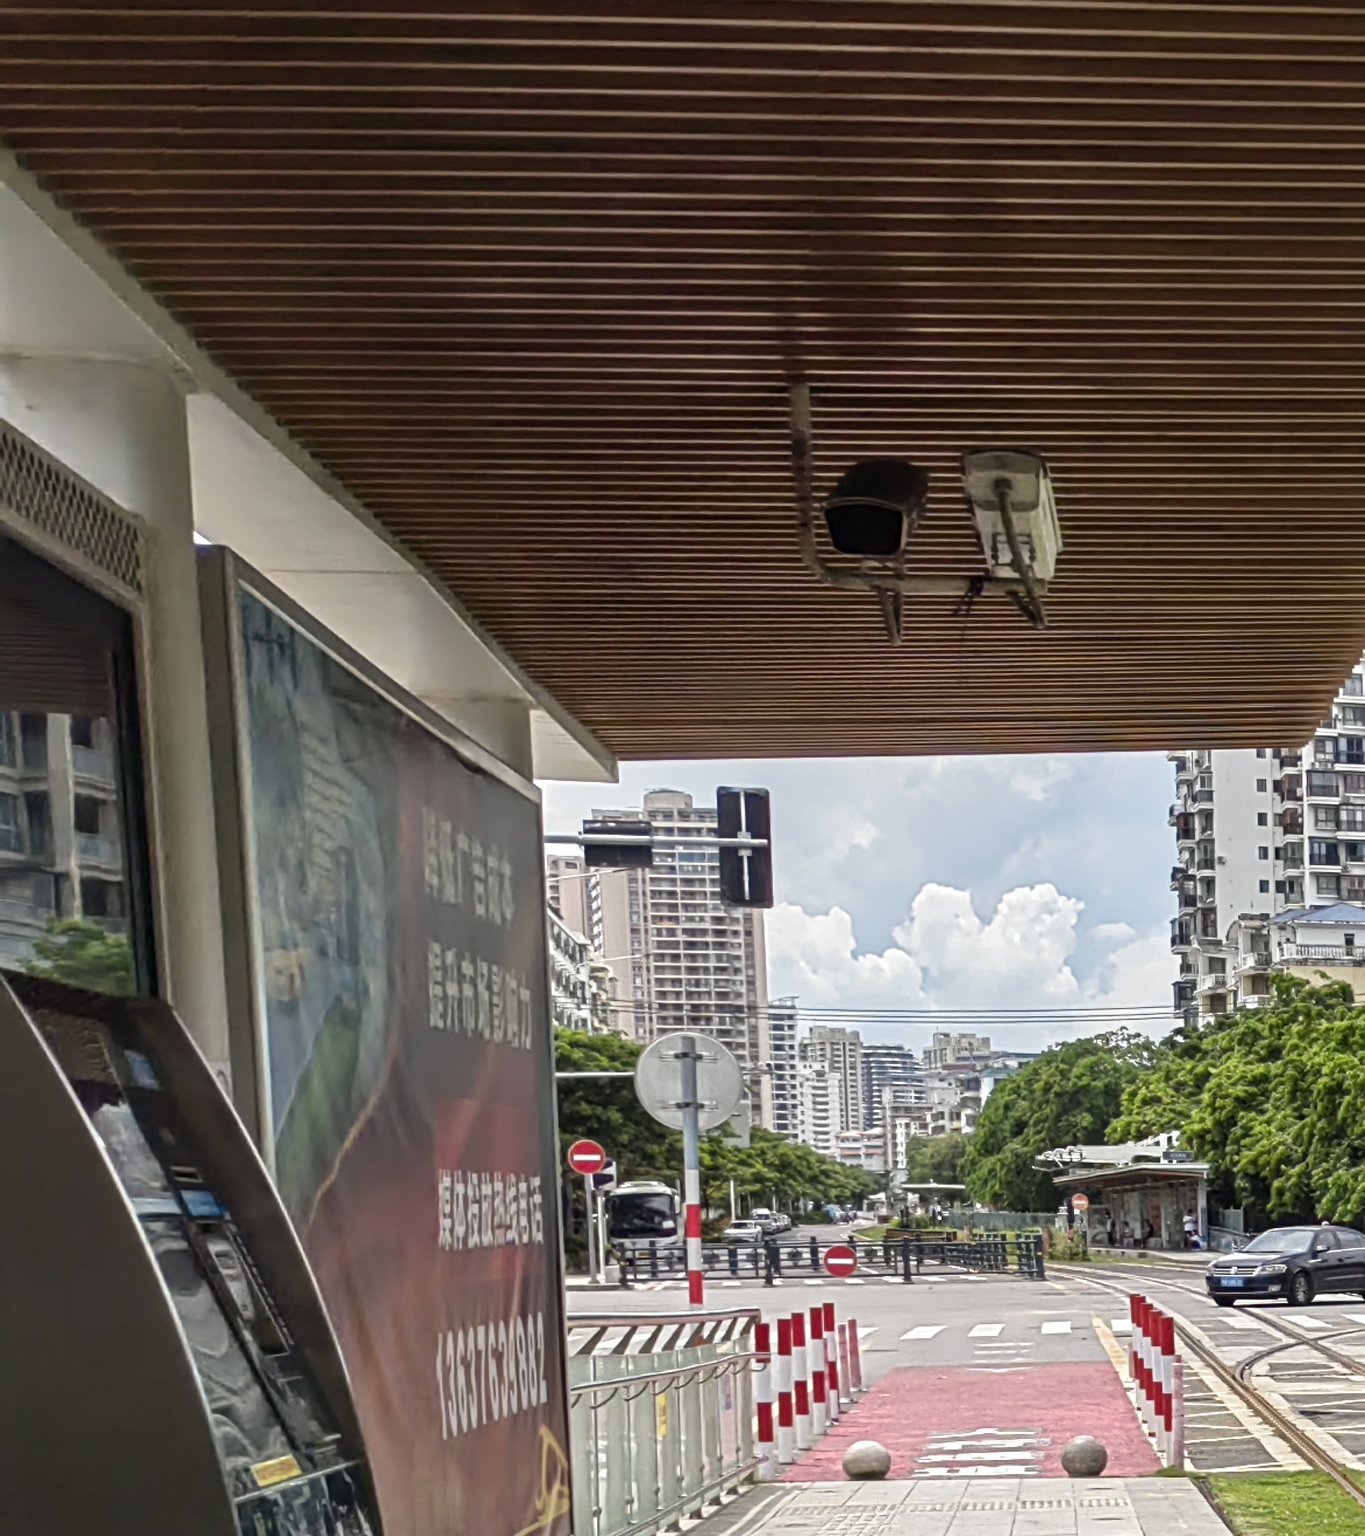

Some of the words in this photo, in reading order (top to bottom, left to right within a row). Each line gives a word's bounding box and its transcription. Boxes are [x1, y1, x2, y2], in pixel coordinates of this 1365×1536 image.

[438, 1168, 544, 1251] 媒体投放热线电话
[436, 1311, 548, 1441] 13637639882
